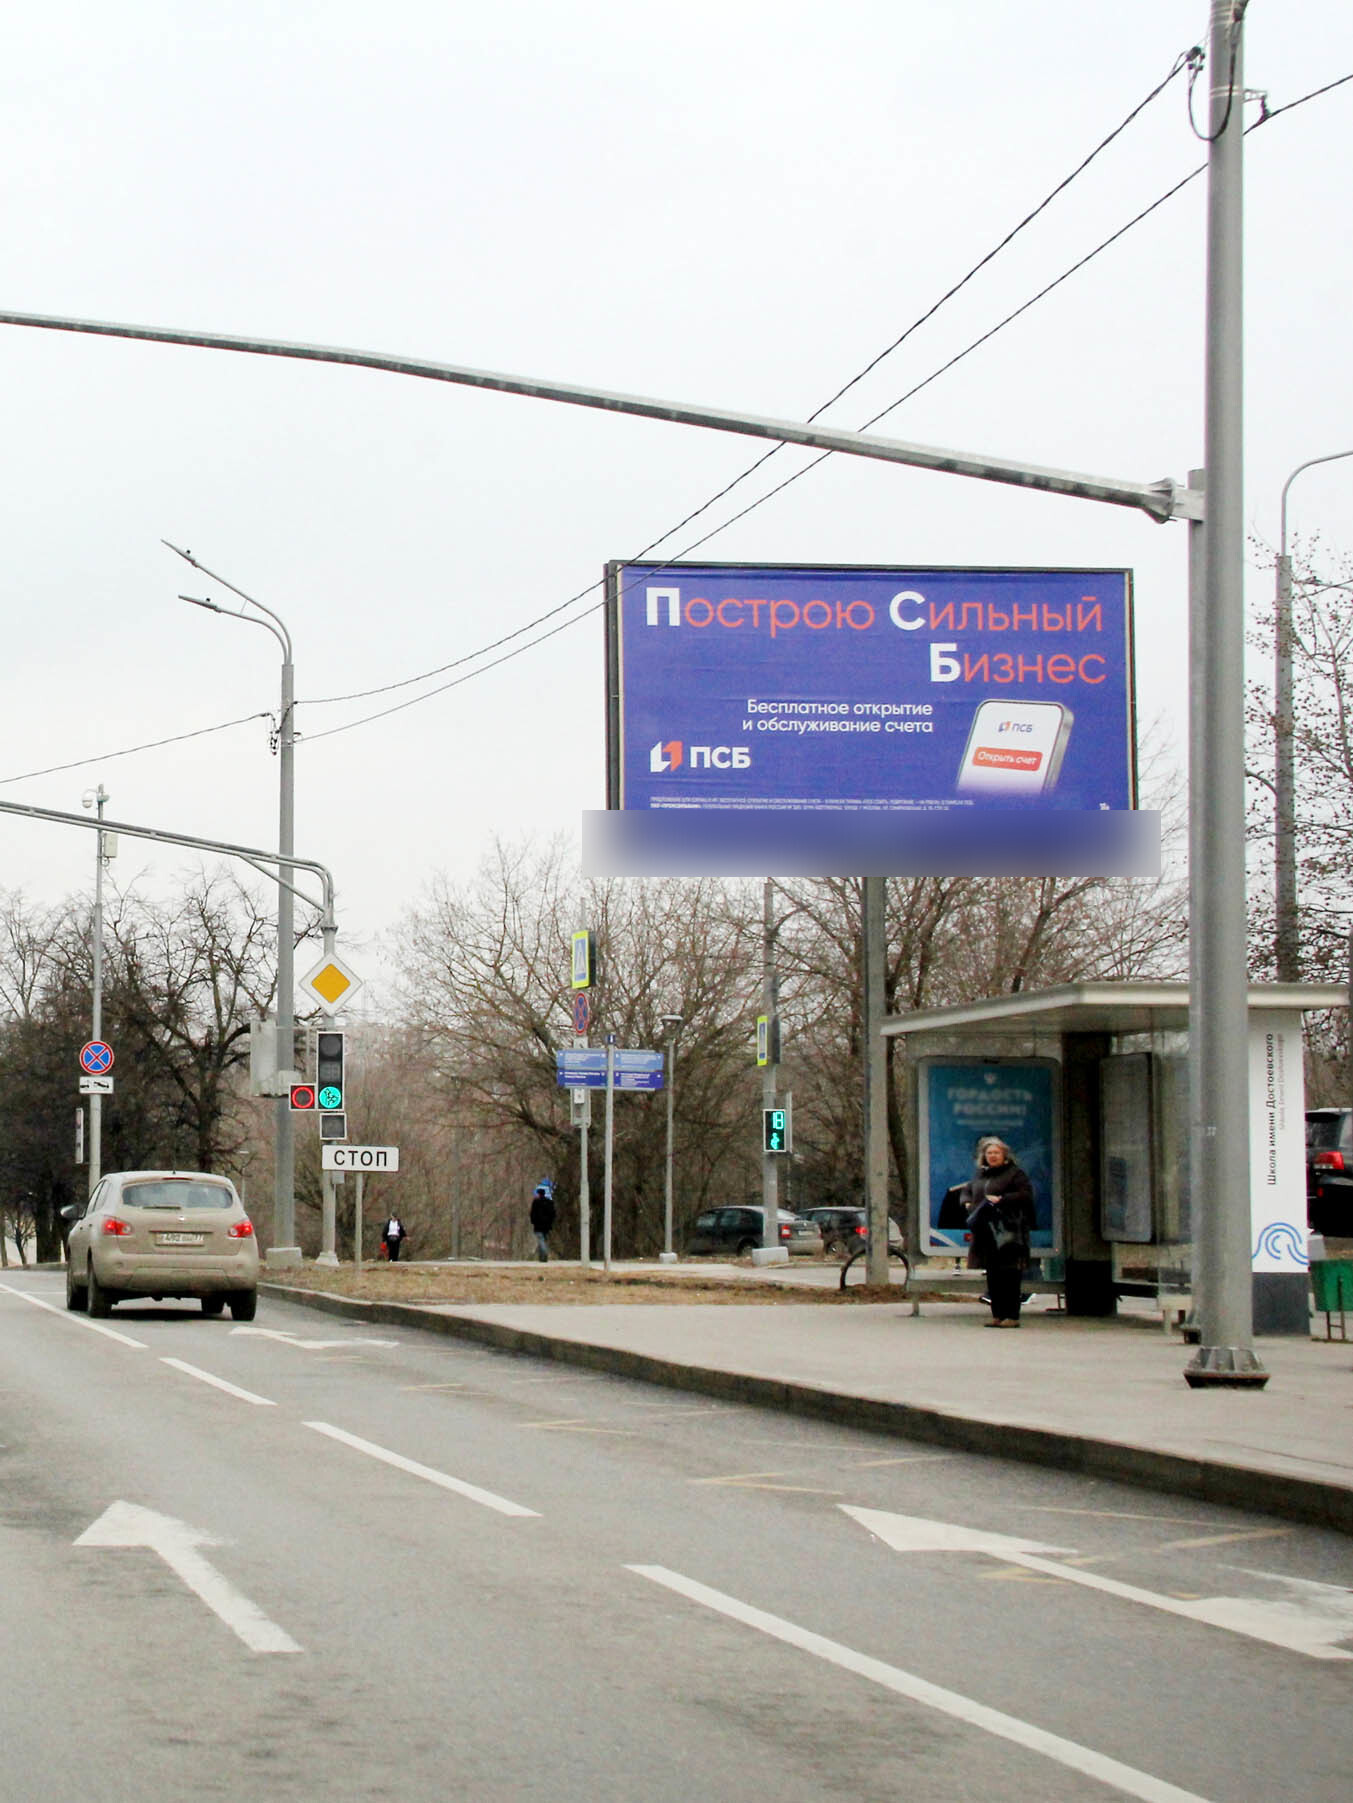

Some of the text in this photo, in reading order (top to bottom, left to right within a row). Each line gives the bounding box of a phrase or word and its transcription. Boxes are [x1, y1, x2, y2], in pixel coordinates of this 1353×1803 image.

[646, 587, 1103, 638] Построю Сильный
[930, 643, 1107, 684] Бизнес
[748, 699, 933, 719] Бесплатное открытие
[742, 718, 933, 735] и обслуживание счета
[1011, 723, 1033, 733] ПСБ
[691, 746, 751, 769] ПСБ
[947, 1087, 1033, 1102] ГОРДОСТЬ
[1266, 1033, 1277, 1185] Школа имени Достоевского
[772, 1111, 784, 1129] 18
[332, 1149, 389, 1169] СТОП
